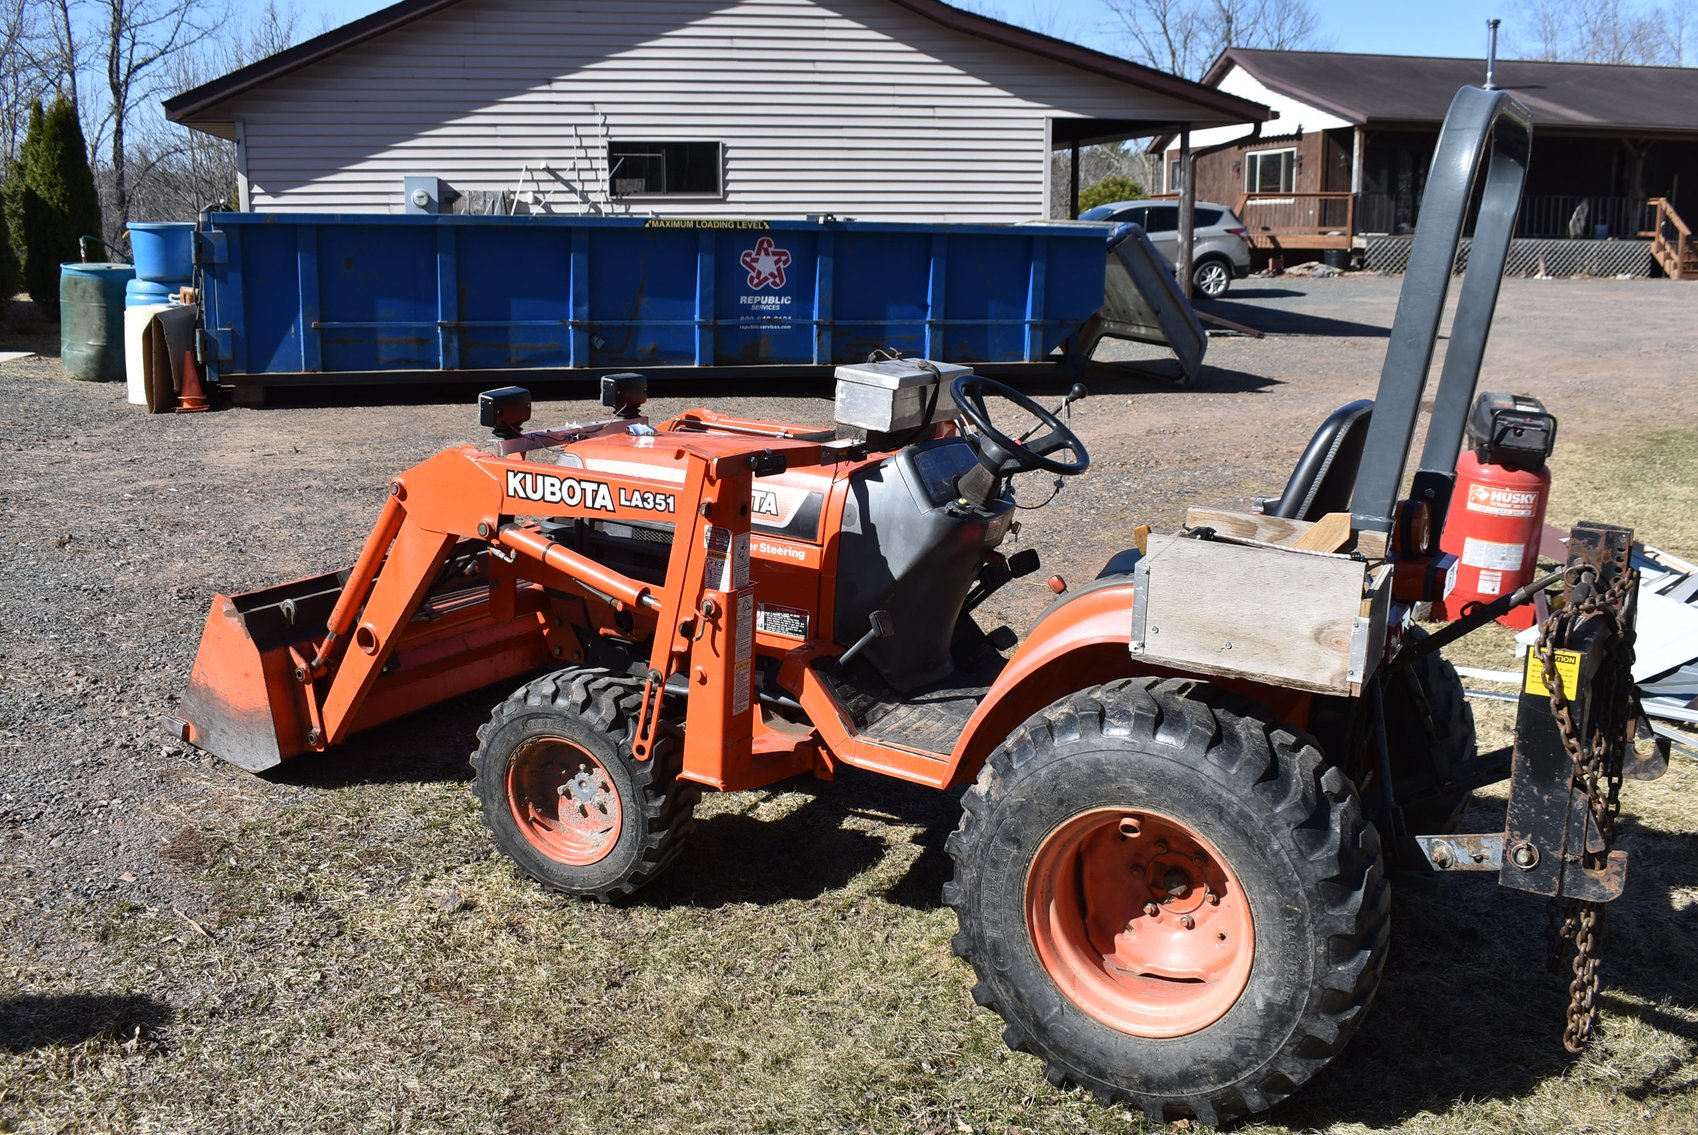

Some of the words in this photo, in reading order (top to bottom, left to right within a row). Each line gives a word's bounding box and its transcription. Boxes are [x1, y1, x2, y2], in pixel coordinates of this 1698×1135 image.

[651, 219, 694, 228] MAXIMUM
[696, 220, 735, 229] LOADING
[736, 221, 763, 229] LEVEL
[739, 295, 792, 305] REPUBLIC
[506, 469, 616, 512] KUBOTA
[619, 487, 676, 513] LA351
[1490, 490, 1537, 505] HUSKY
[759, 542, 805, 561] Steering
[982, 838, 1021, 944] TITAN
